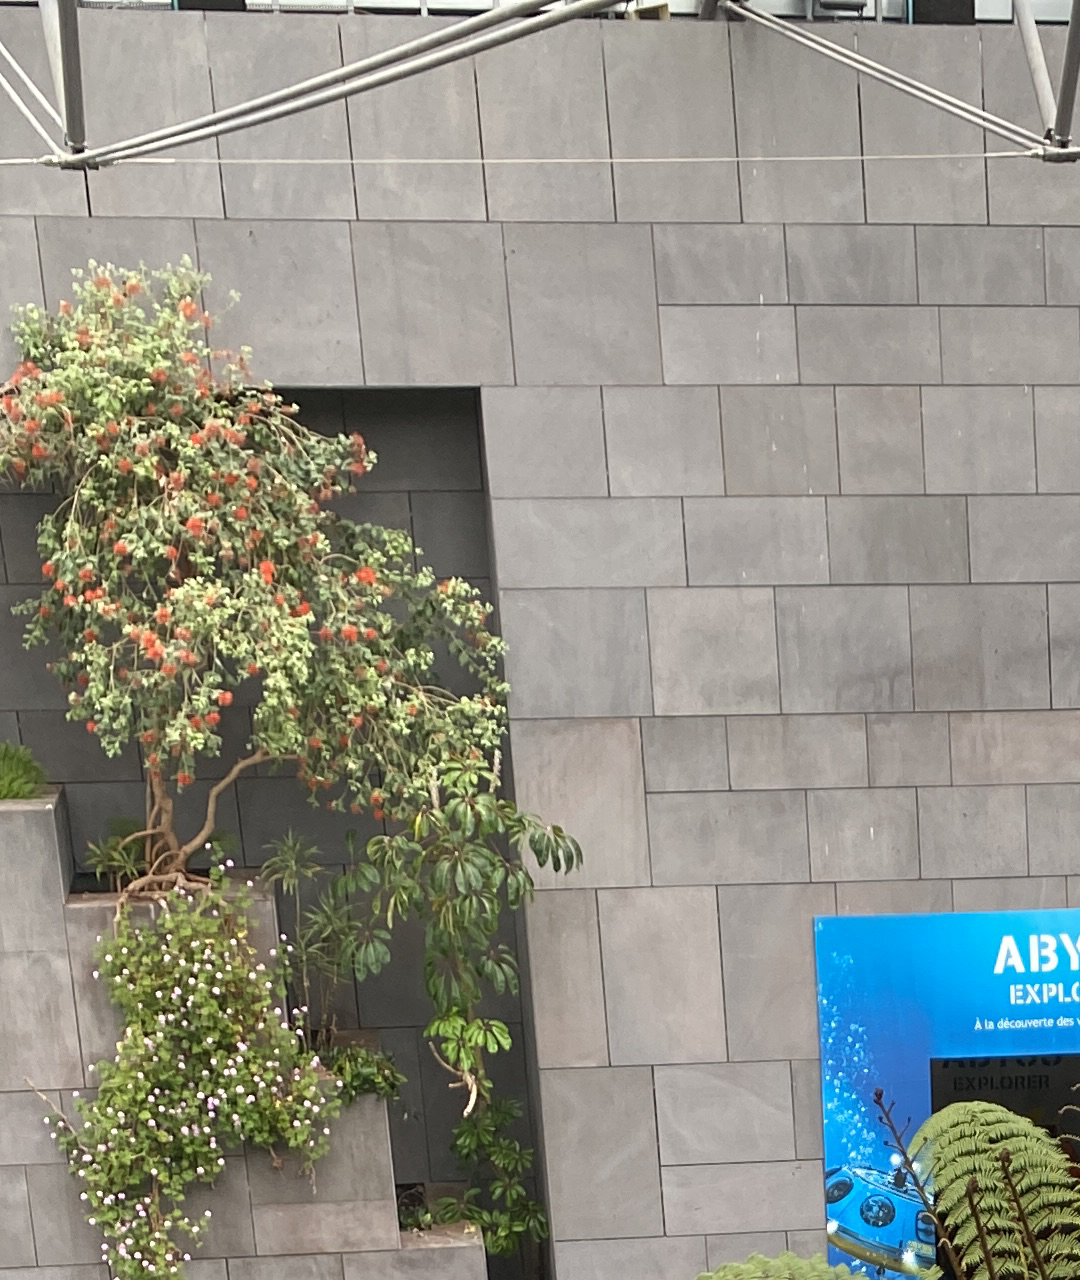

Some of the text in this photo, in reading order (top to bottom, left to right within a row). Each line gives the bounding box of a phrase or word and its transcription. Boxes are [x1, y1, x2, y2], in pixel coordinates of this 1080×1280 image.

[984, 1018, 995, 1030] la
[997, 1016, 1055, 1029] découverte
[1056, 1015, 1075, 1027] des
[953, 1073, 1050, 1092] EXPLORER
